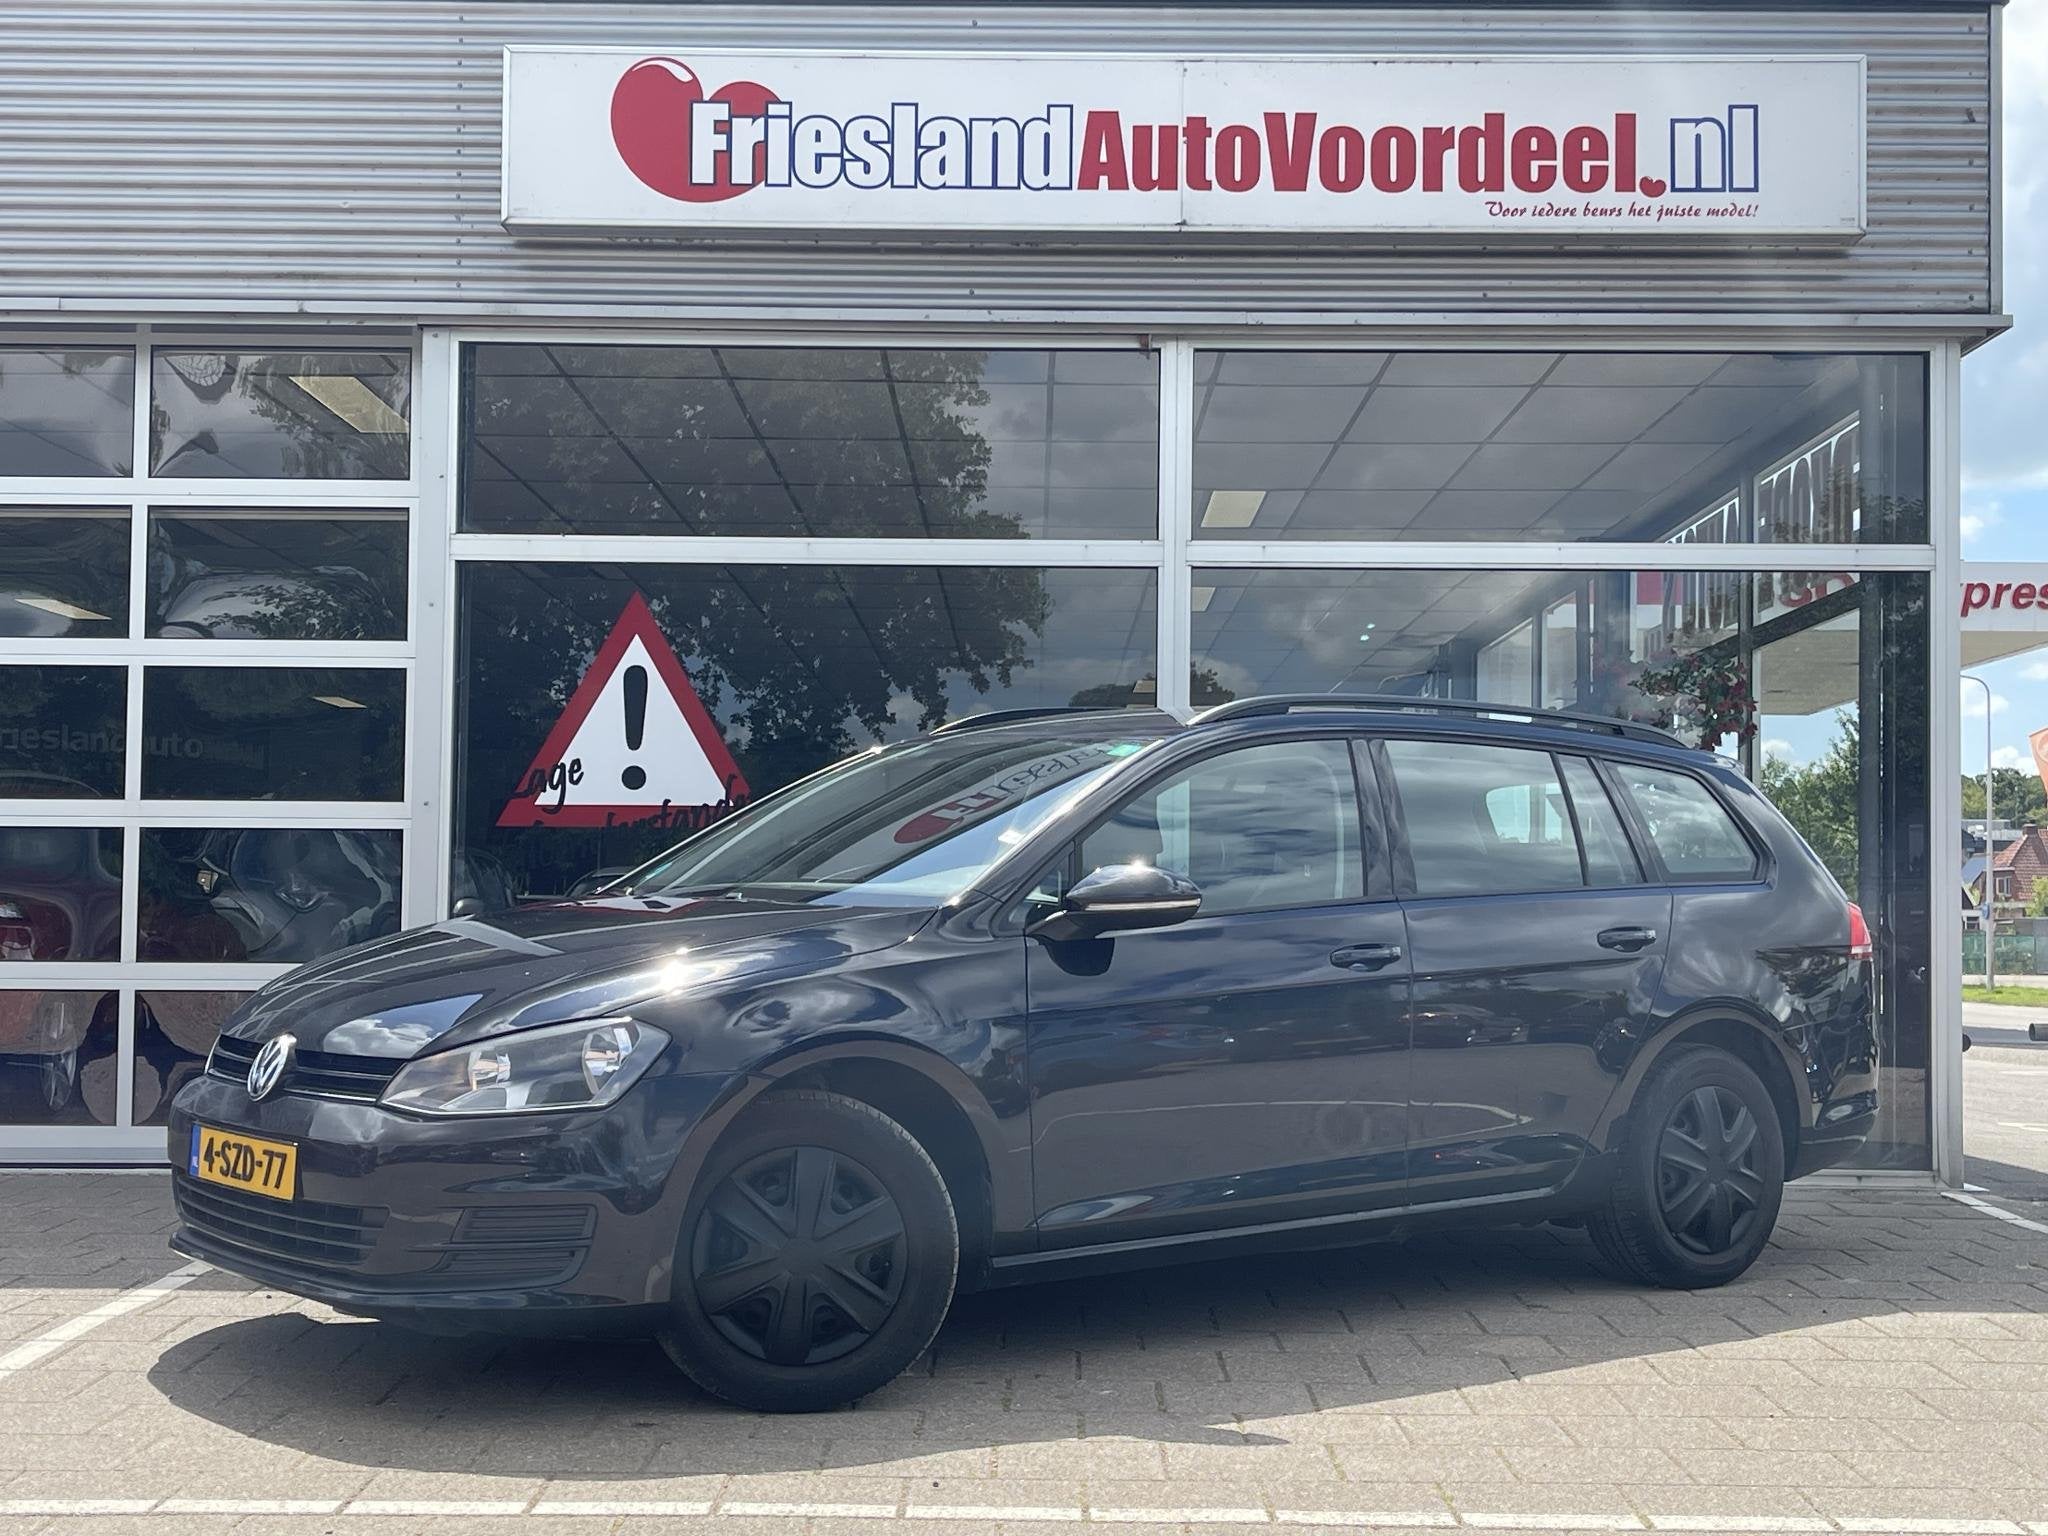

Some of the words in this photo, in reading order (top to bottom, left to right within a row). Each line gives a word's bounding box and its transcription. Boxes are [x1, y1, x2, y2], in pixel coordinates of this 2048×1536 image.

[1484, 201, 1527, 217] Voor
[1531, 201, 1578, 217] iedere
[1582, 201, 1623, 217] beurs
[1628, 202, 1652, 217] het
[1656, 202, 1702, 222] juiste
[1706, 201, 1759, 218] model!
[203, 1136, 288, 1190] 4-SZD-77
